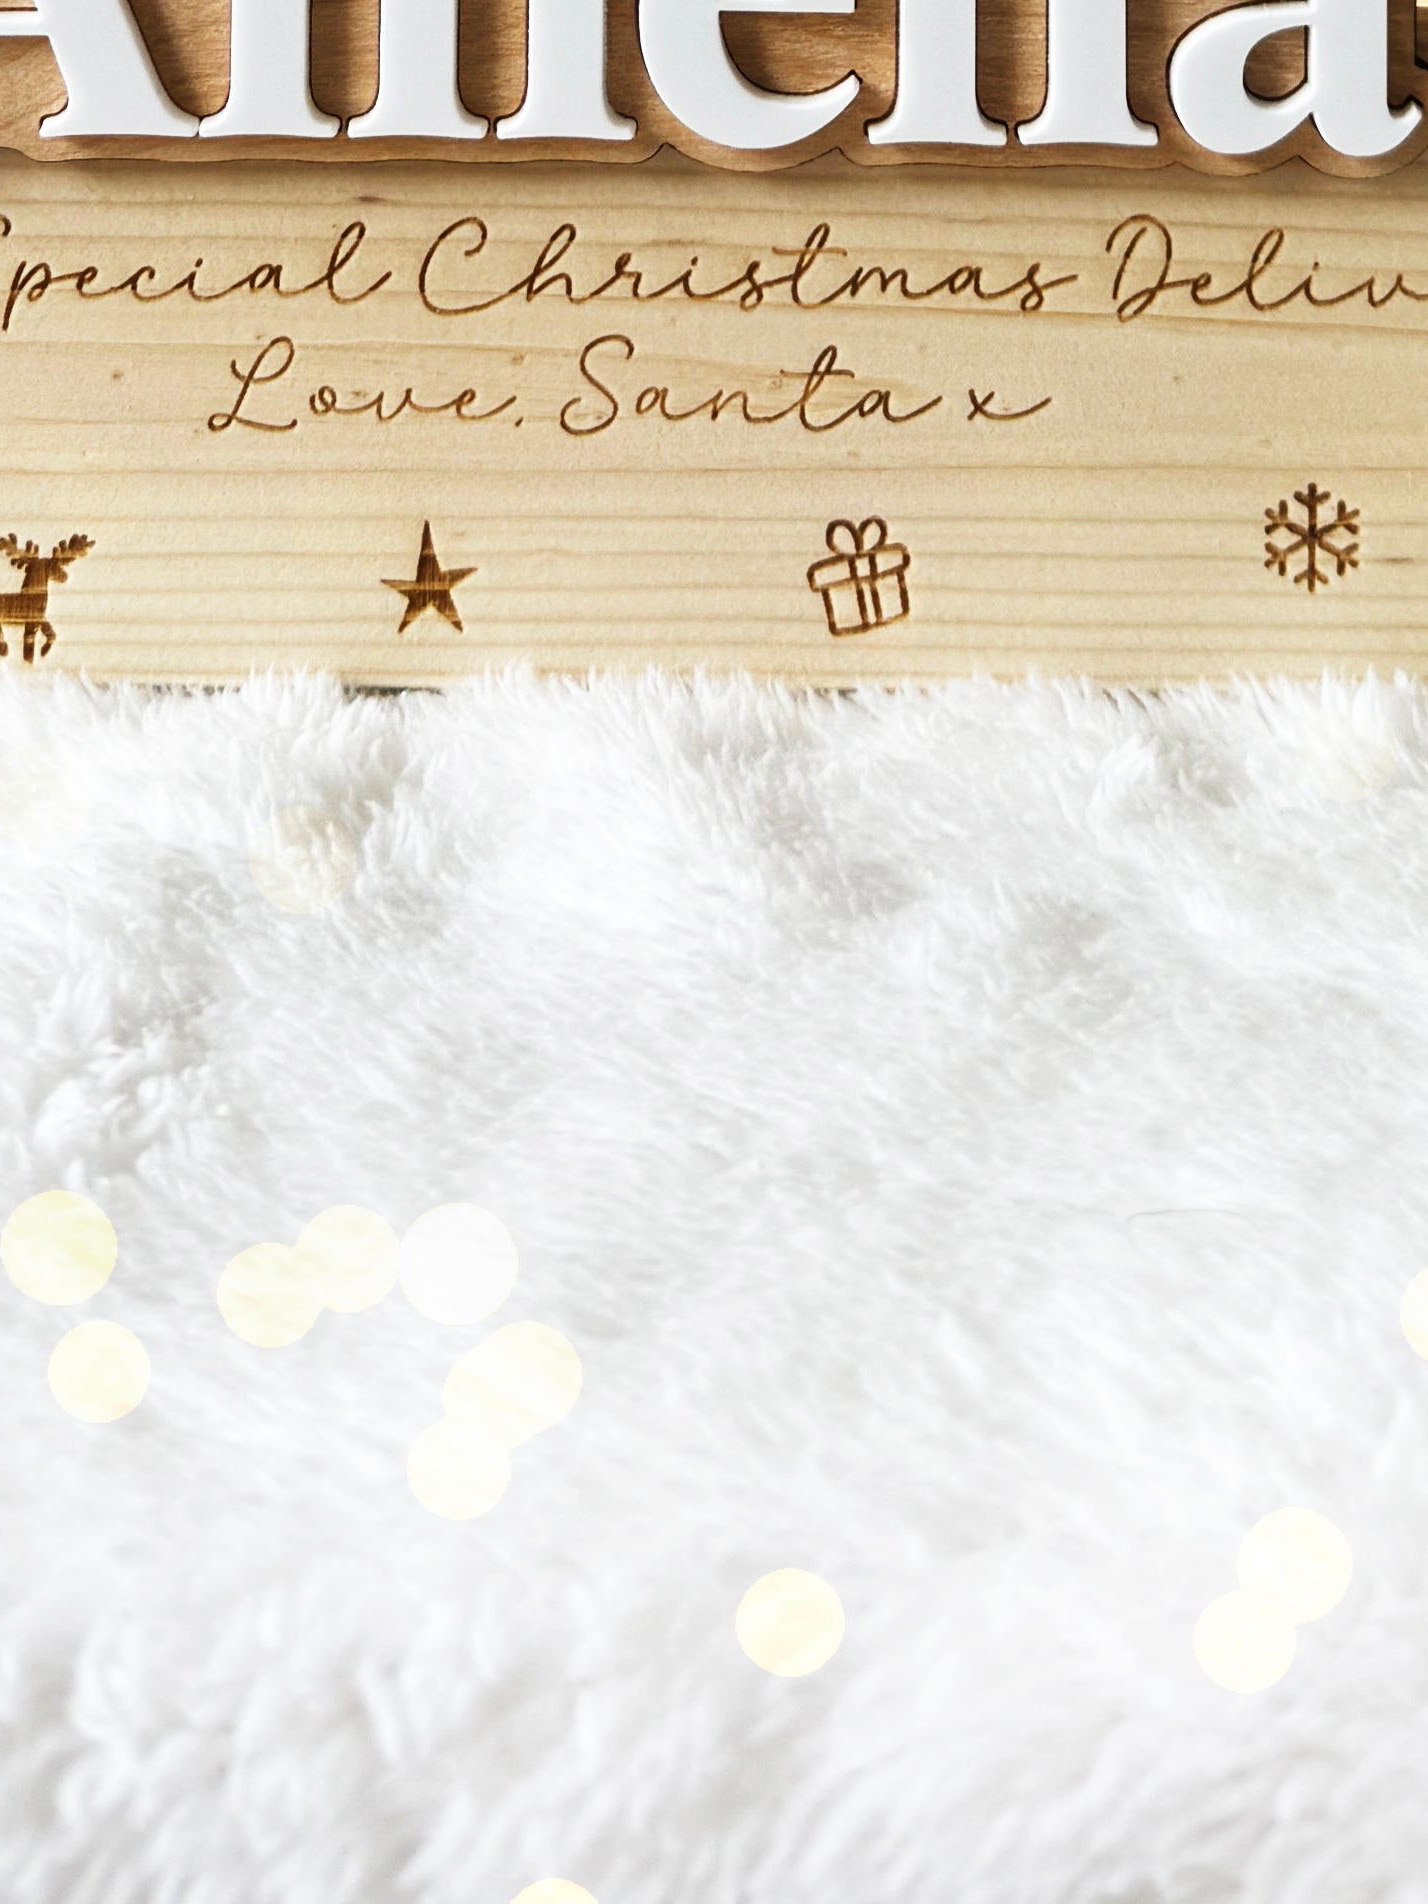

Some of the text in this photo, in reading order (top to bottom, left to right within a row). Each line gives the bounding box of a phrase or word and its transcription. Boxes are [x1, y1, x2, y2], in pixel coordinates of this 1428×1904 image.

[417, 215, 1080, 316] Christmas
[558, 332, 945, 439] Santa
[966, 386, 1053, 423] x
